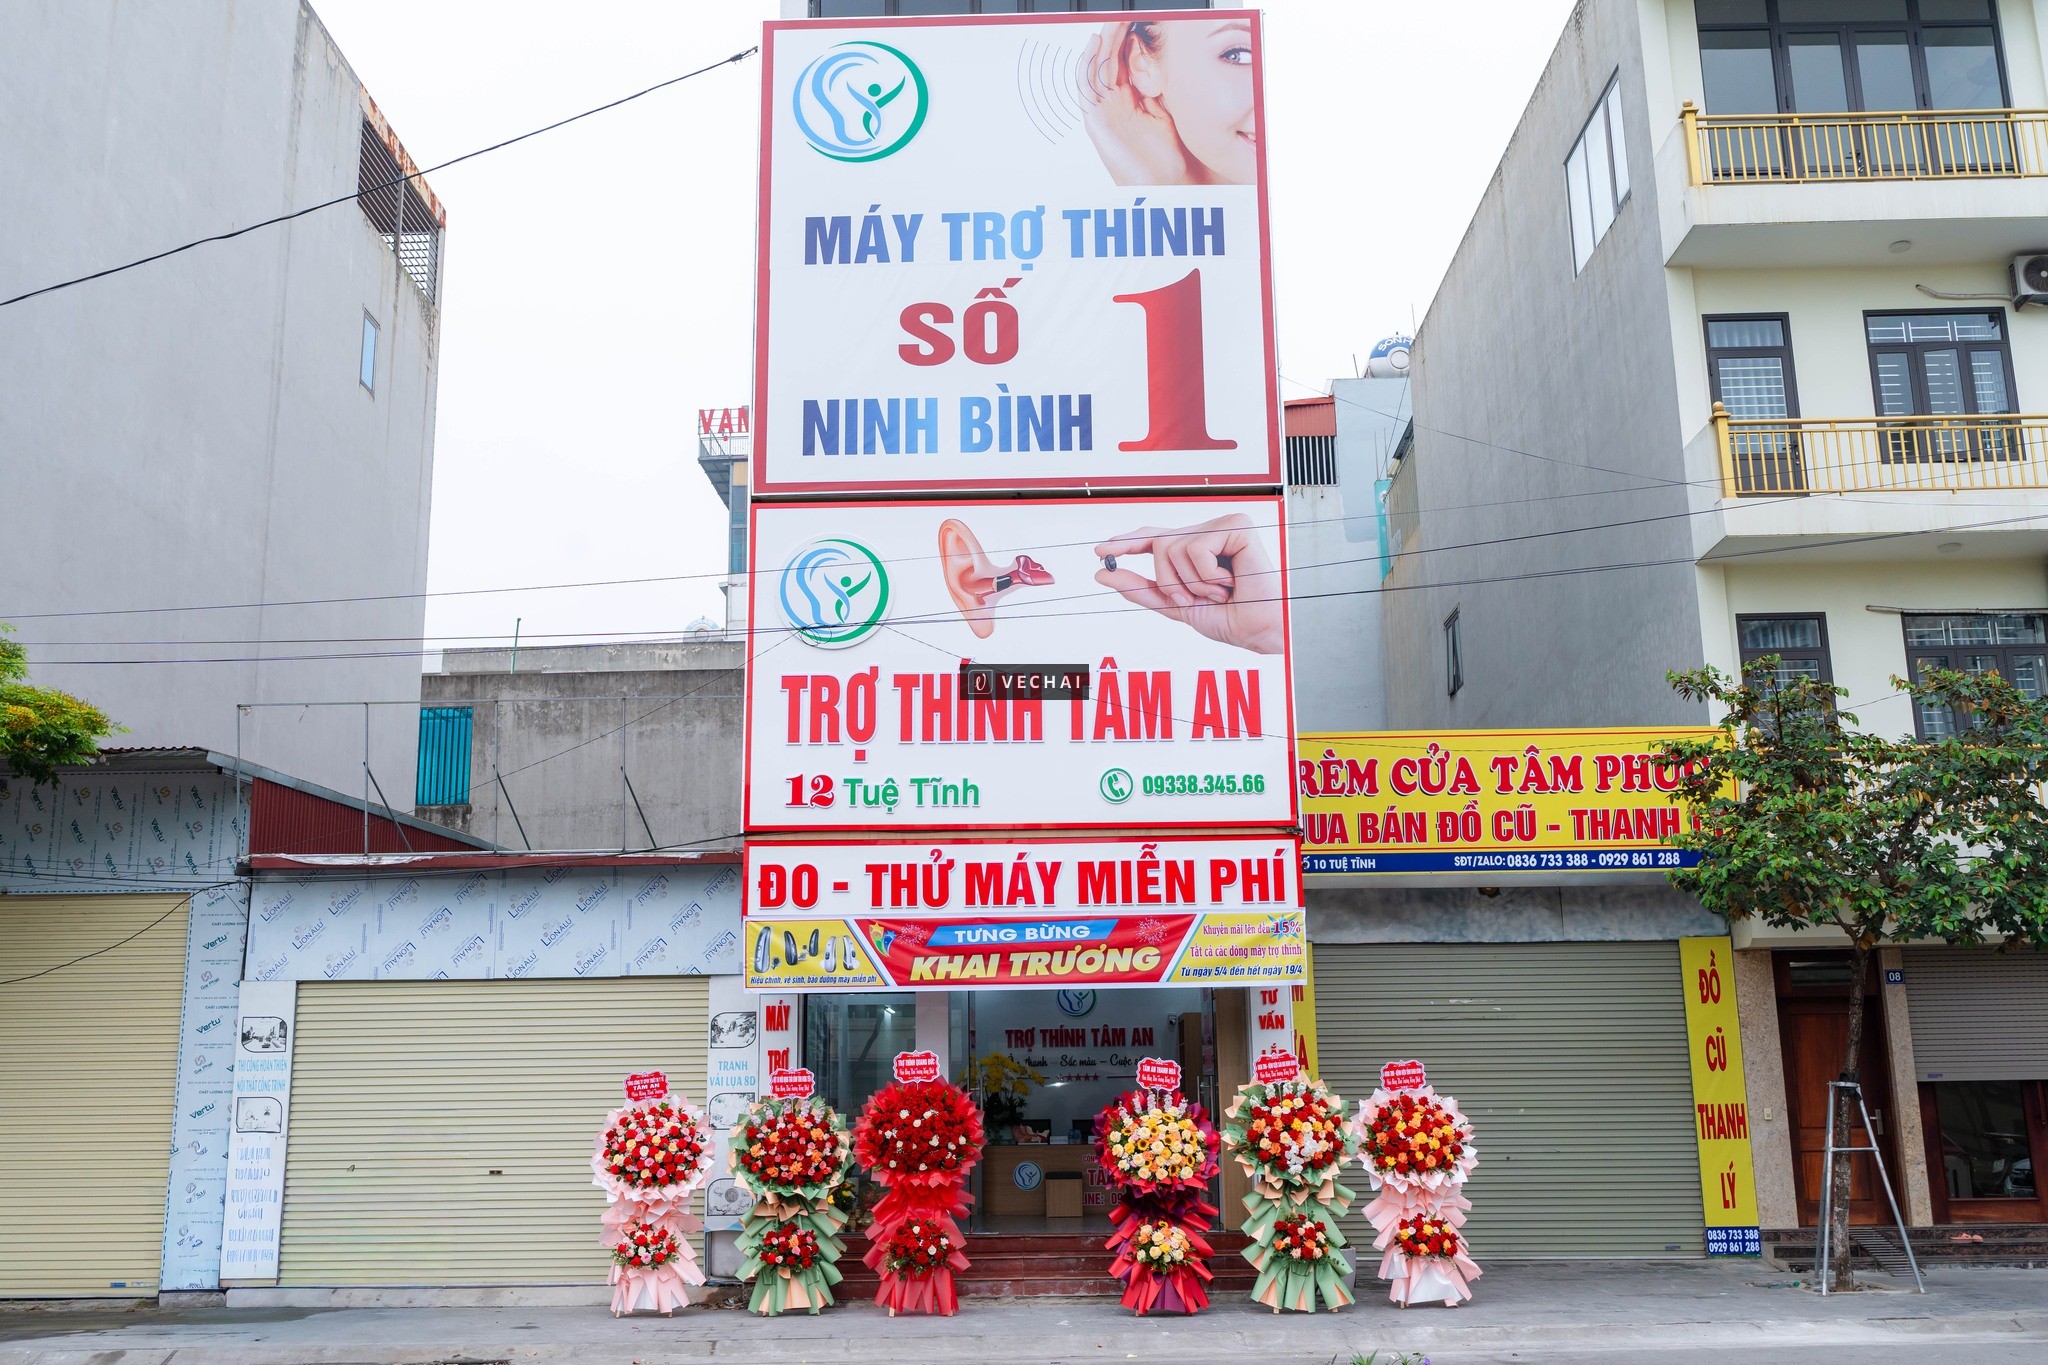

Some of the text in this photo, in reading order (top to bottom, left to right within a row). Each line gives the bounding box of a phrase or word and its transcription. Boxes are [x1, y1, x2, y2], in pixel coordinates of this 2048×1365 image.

[804, 197, 1226, 271] MÁY TRỢ THÍNH
[898, 277, 1023, 367] SỐ
[1112, 268, 1238, 452] 1
[802, 383, 1093, 456] NINH BÌNH
[780, 656, 1263, 763] TRỢ THÍNH TÂM AN
[1390, 742, 1481, 796] CỬA
[1490, 744, 1583, 794] TÂM
[785, 775, 981, 814] 12 Tuệ Tĩnh
[1142, 774, 1266, 796] 09338.345.66
[1301, 813, 1349, 845] UA
[1360, 806, 1427, 845] BÁN
[1436, 800, 1483, 844] ĐỒ
[1491, 803, 1537, 842] CŨ
[1547, 822, 1562, 834] -
[1569, 807, 1681, 841] THANH
[1313, 856, 1376, 871] 10 TUỆ TĨNH
[1454, 855, 1506, 868] SĐT/ZALO:
[1507, 854, 1538, 867] 0836
[1541, 854, 1563, 867] 733
[1566, 853, 1589, 866] 388
[1598, 853, 1628, 866] 0929
[1631, 853, 1653, 865] 861
[1658, 852, 1680, 865] 288
[757, 843, 1288, 909] ĐO - THỬ MÁY MIỄN PHÍ
[1025, 924, 1091, 940] BỪNG
[910, 944, 1161, 982] KHAI TRƯƠNG
[1215, 944, 1227, 957] các
[1250, 944, 1266, 958] máy
[1268, 944, 1279, 958] trợ
[1192, 966, 1213, 977] ngày
[1214, 966, 1228, 976] 5/4
[1229, 964, 1245, 976] đến
[1247, 963, 1260, 976] hết
[1262, 965, 1282, 976] ngày
[1285, 964, 1303, 975] 19/4
[1699, 950, 1721, 1004] ĐỒ
[1888, 971, 1901, 982] 08
[1260, 988, 1278, 1005] TƯ
[765, 1000, 791, 1031] MÁY
[1258, 1010, 1285, 1030] VẤN
[1005, 1024, 1154, 1052] TRỢ THÍNH TÂM AN
[1705, 1026, 1727, 1072] CŨ
[709, 1073, 756, 1090] VẢI LỤA 8D
[718, 1060, 748, 1072] TRANH
[1697, 1103, 1747, 1140] THANH
[1720, 1161, 1737, 1209] LÝ
[1707, 1229, 1759, 1240] 0836 733 388
[1709, 1242, 1760, 1253] 0929 861 288
